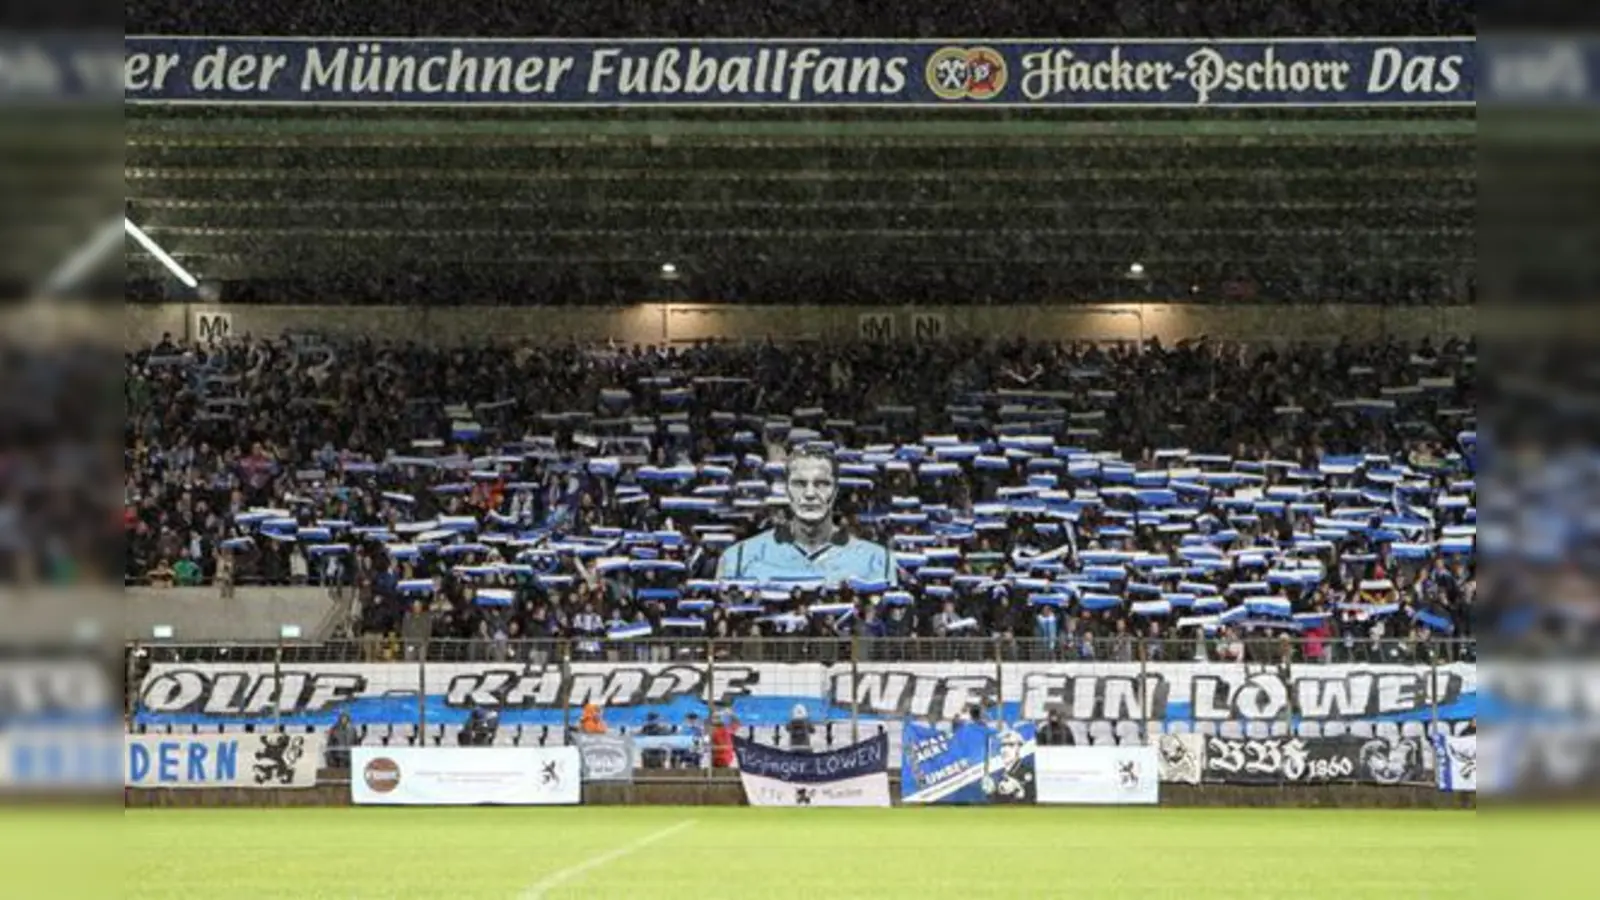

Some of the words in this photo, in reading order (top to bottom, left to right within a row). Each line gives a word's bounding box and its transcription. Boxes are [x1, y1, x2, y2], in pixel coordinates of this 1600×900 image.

[192, 46, 287, 91] der
[301, 43, 572, 92] Münchner
[587, 48, 909, 100] Fußballfans
[1021, 47, 1351, 103] Hacker-Pschorr
[1368, 47, 1464, 93] Das
[141, 669, 367, 717] OLAF
[445, 660, 760, 706] KÄMPF
[830, 671, 1000, 719] WIE
[1022, 672, 1171, 719] EIN
[130, 740, 238, 782] DERN
[1308, 755, 1353, 777] 1860
